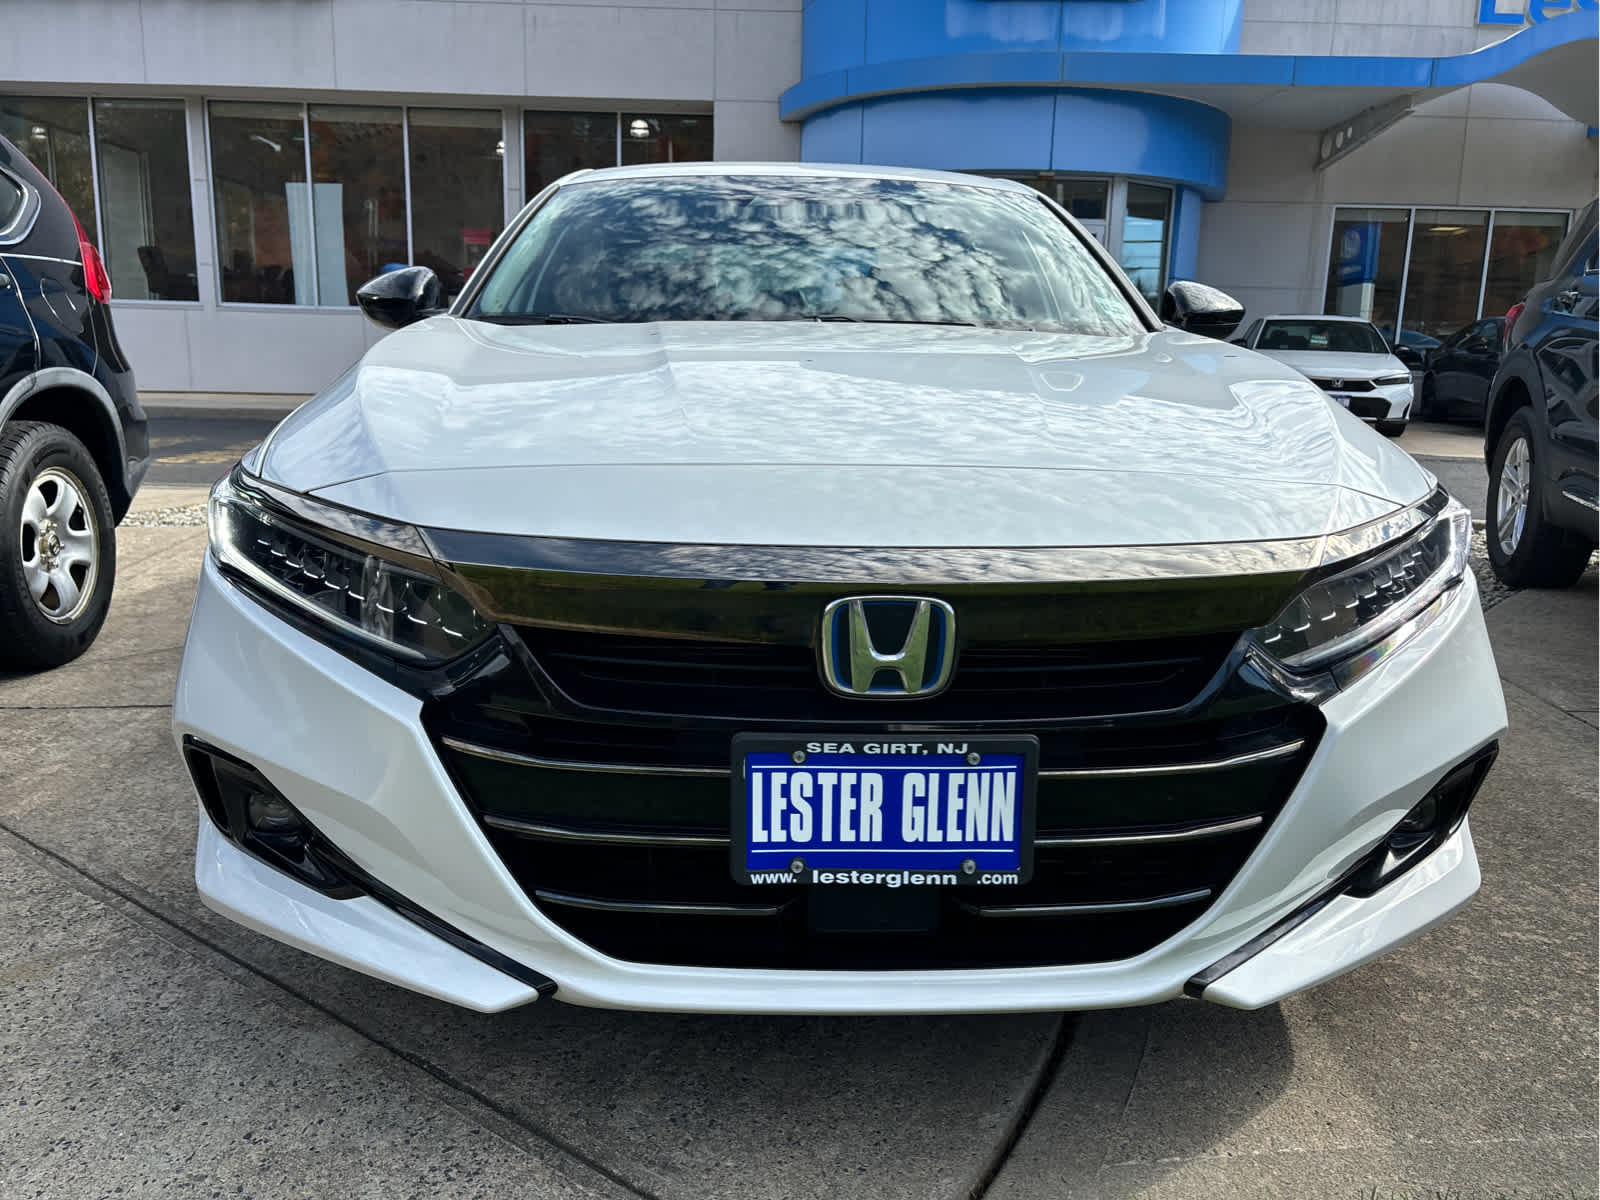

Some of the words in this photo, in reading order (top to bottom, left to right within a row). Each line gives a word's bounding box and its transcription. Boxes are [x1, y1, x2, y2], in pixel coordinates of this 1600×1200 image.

[807, 743, 855, 753] SEA
[864, 744, 927, 754] GIRT,
[938, 744, 967, 753] NJ
[752, 772, 883, 842] LESTER
[902, 772, 1016, 842] GLENN
[751, 872, 797, 884] www.
[813, 870, 956, 887] lesterglenn
[977, 874, 1018, 884] .com
